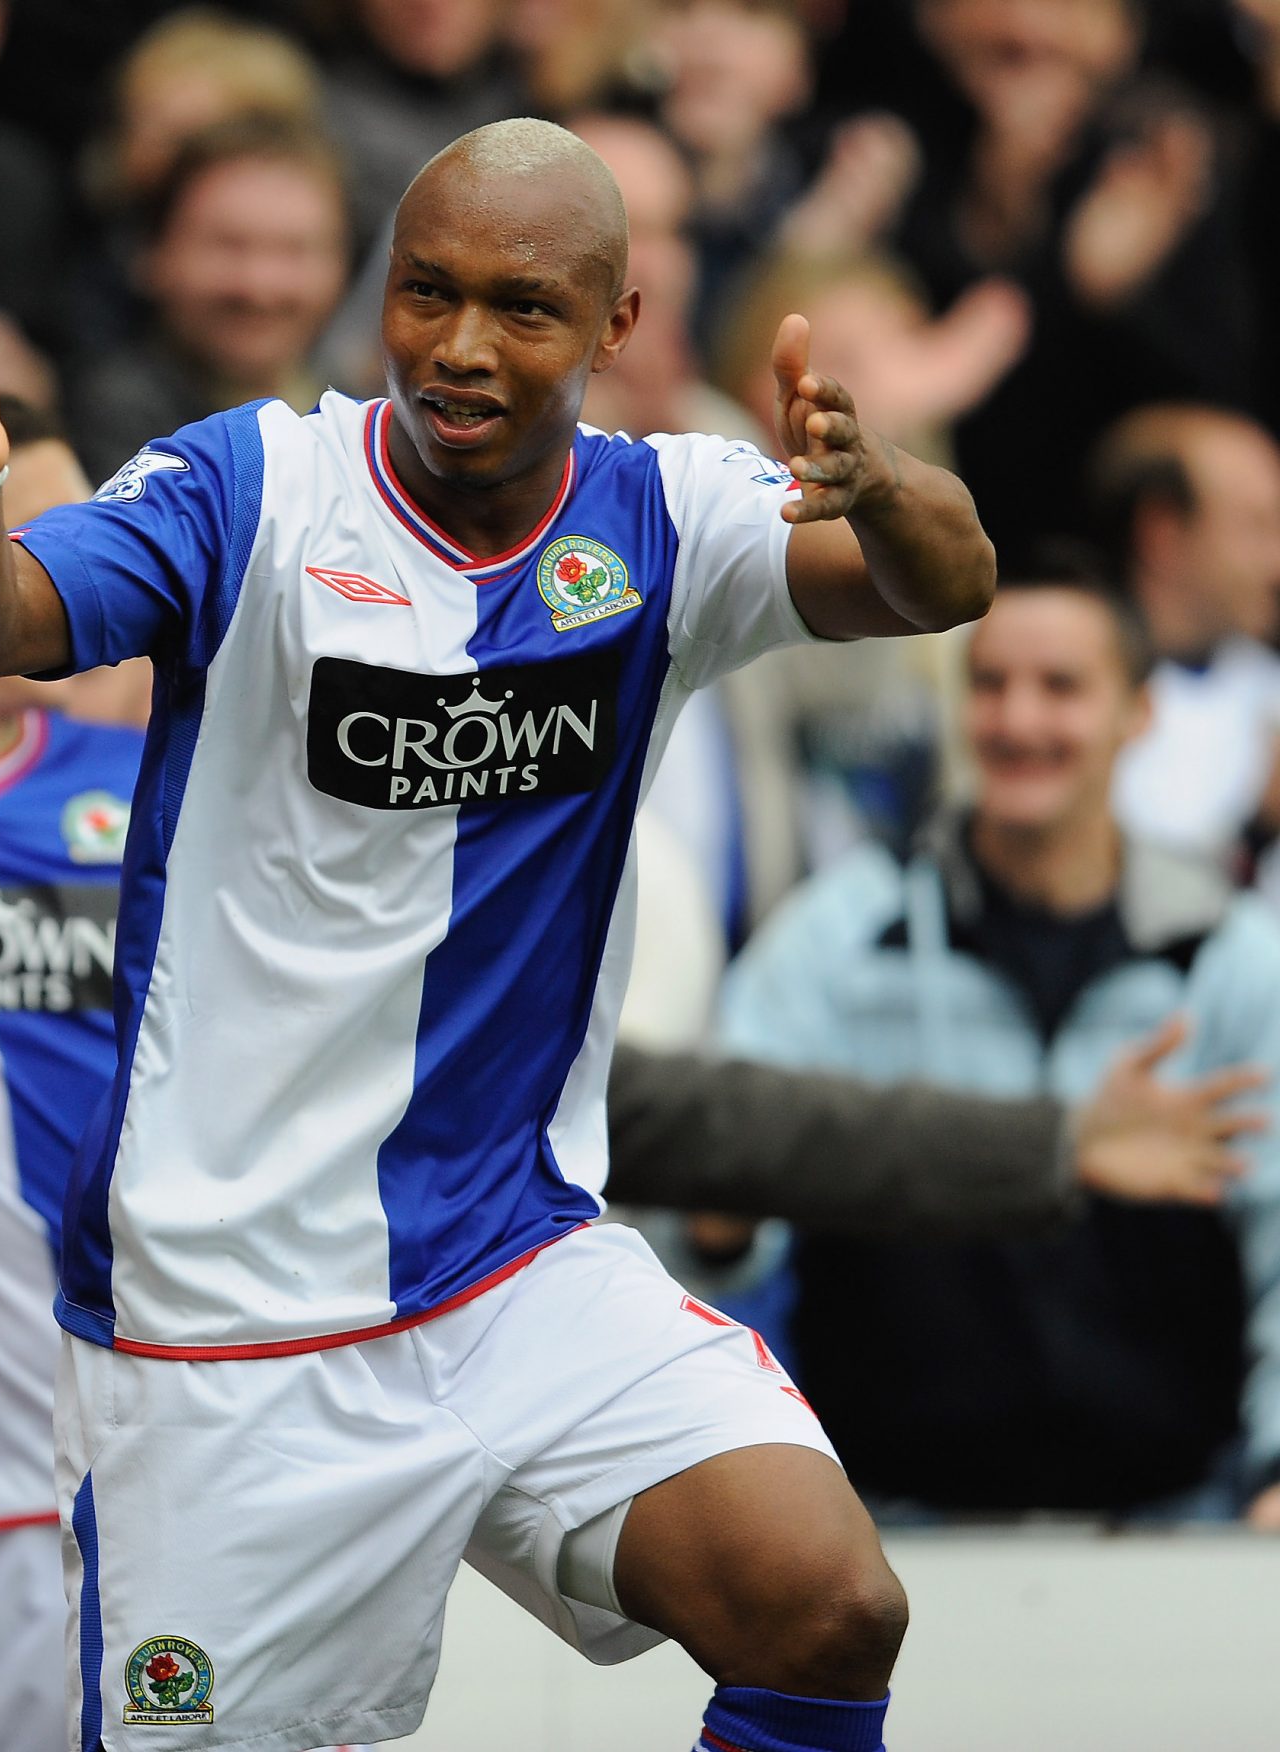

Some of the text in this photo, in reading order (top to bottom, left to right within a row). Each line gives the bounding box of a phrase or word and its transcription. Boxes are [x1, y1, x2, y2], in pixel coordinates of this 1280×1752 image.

[569, 541, 614, 565] ROVERS
[336, 699, 598, 770] CROWN
[388, 763, 540, 804] PAINTS
